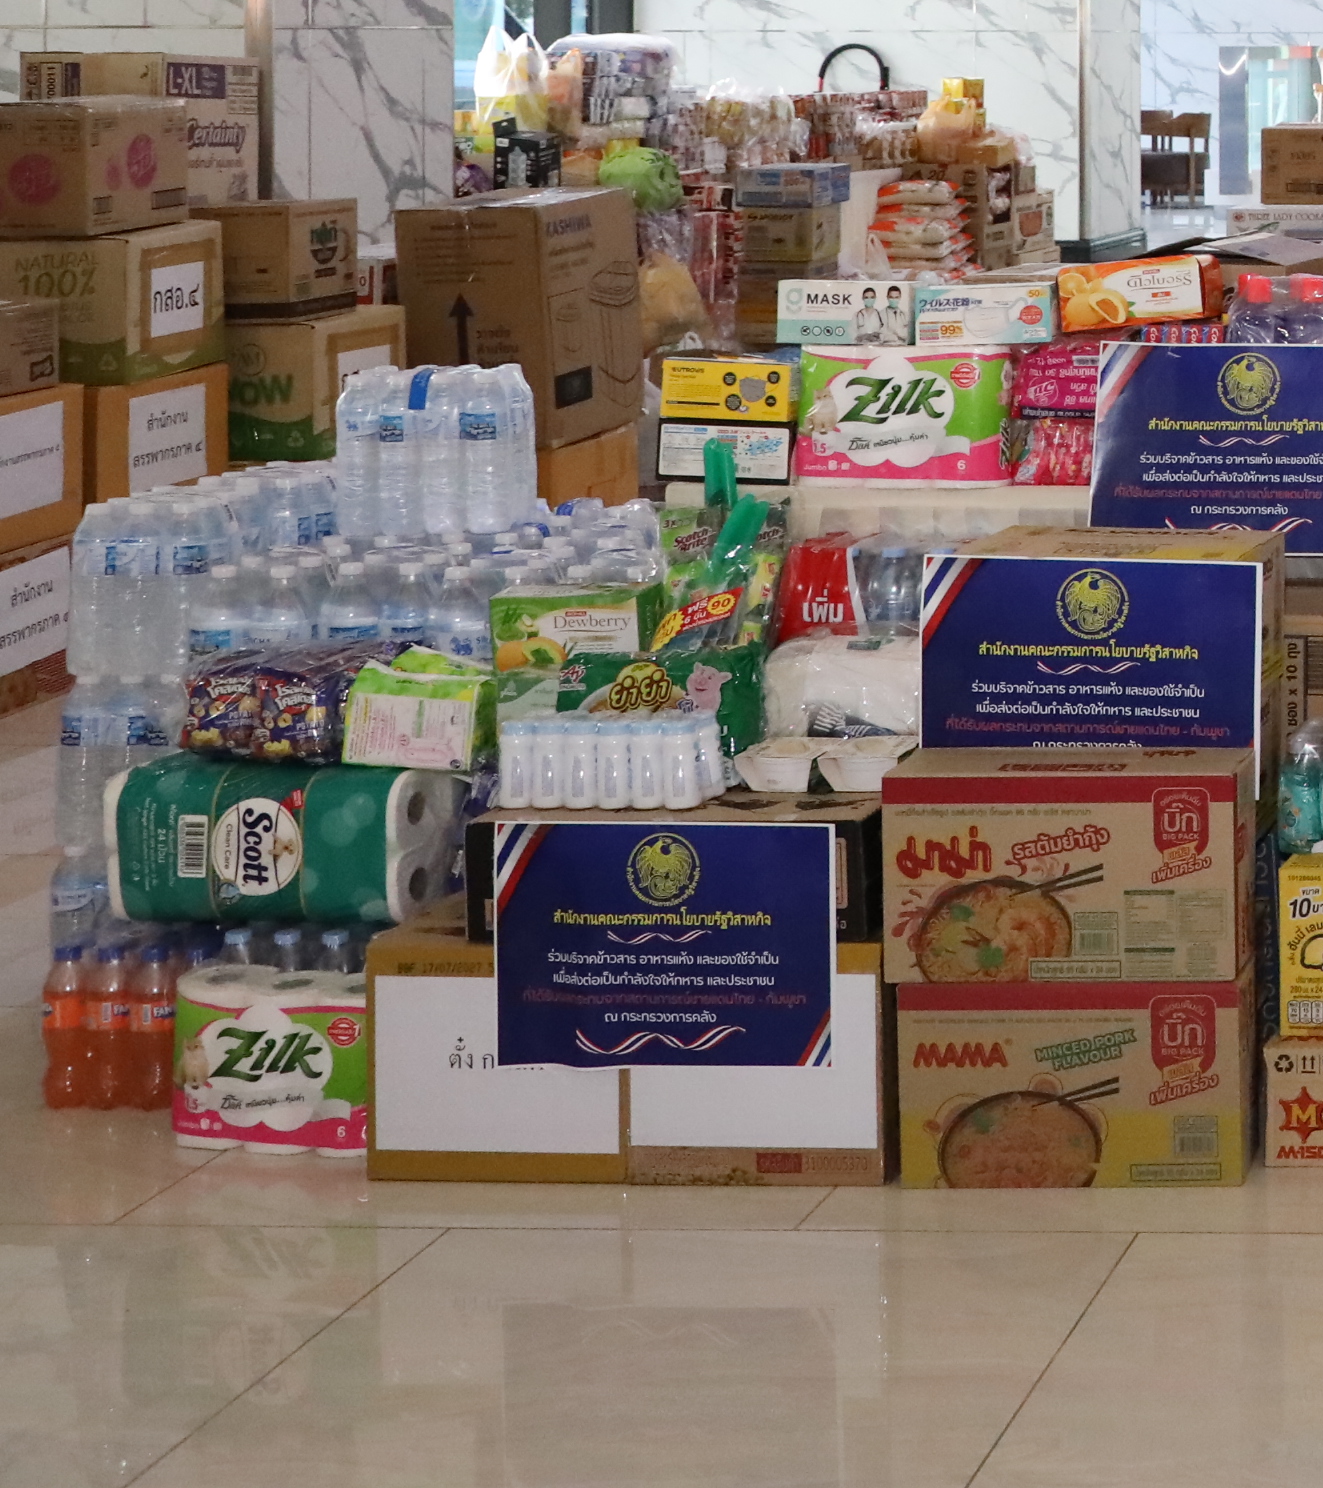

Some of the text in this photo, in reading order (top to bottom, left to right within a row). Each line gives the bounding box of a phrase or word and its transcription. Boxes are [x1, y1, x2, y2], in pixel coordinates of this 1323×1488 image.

[168, 67, 202, 95] L-XL
[18, 269, 97, 299] 100%
[153, 284, 200, 314] กสอ.๔
[807, 293, 852, 306] MASK
[838, 375, 946, 424] Zilk
[956, 459, 966, 471] 6
[1139, 452, 1223, 465] ร่วมบริจาคข้าวสาร
[1225, 452, 1273, 465] อาหารแห้ง
[1142, 470, 1280, 483] เพื่อส่งต่อเป็นกำลังใจให้ทหาร
[1204, 503, 1289, 517] กระทรวงการคลัง
[10, 578, 54, 608] สำนักงาน
[711, 597, 732, 610] 90
[553, 613, 632, 631] Dewberry
[978, 640, 1198, 663] สำนักงานคณะกรรมการนโยบายรัฐวิสาหกิจ
[1286, 664, 1298, 682] 10
[972, 681, 1205, 699] ร่วมบริจาคข้าวสาร อาหารแห้ง และของใช้จำเป็น
[976, 700, 1199, 719] เพื่อส่งต่อเป็นกำลังใจให้ทหาร และประชาชน
[223, 823, 233, 870] Clean Care
[242, 807, 274, 887] Scott
[553, 907, 772, 930] สำนักงานคณะกรรมการนโยบายรัฐวิสาหกิจ
[548, 949, 779, 966] ร่วมบริจาคข้าวสาร อาหารแห้ง และของใช้จำเป็น
[552, 969, 775, 987] เพื่อส่งต่อเป็นกำลังใจให้ทหาร และประชาชน
[621, 1010, 717, 1024] กระทรวงการคลัง
[1095, 1028, 1138, 1049] PORK
[209, 1026, 324, 1083] Zilk
[912, 1042, 1009, 1069] MAMA
